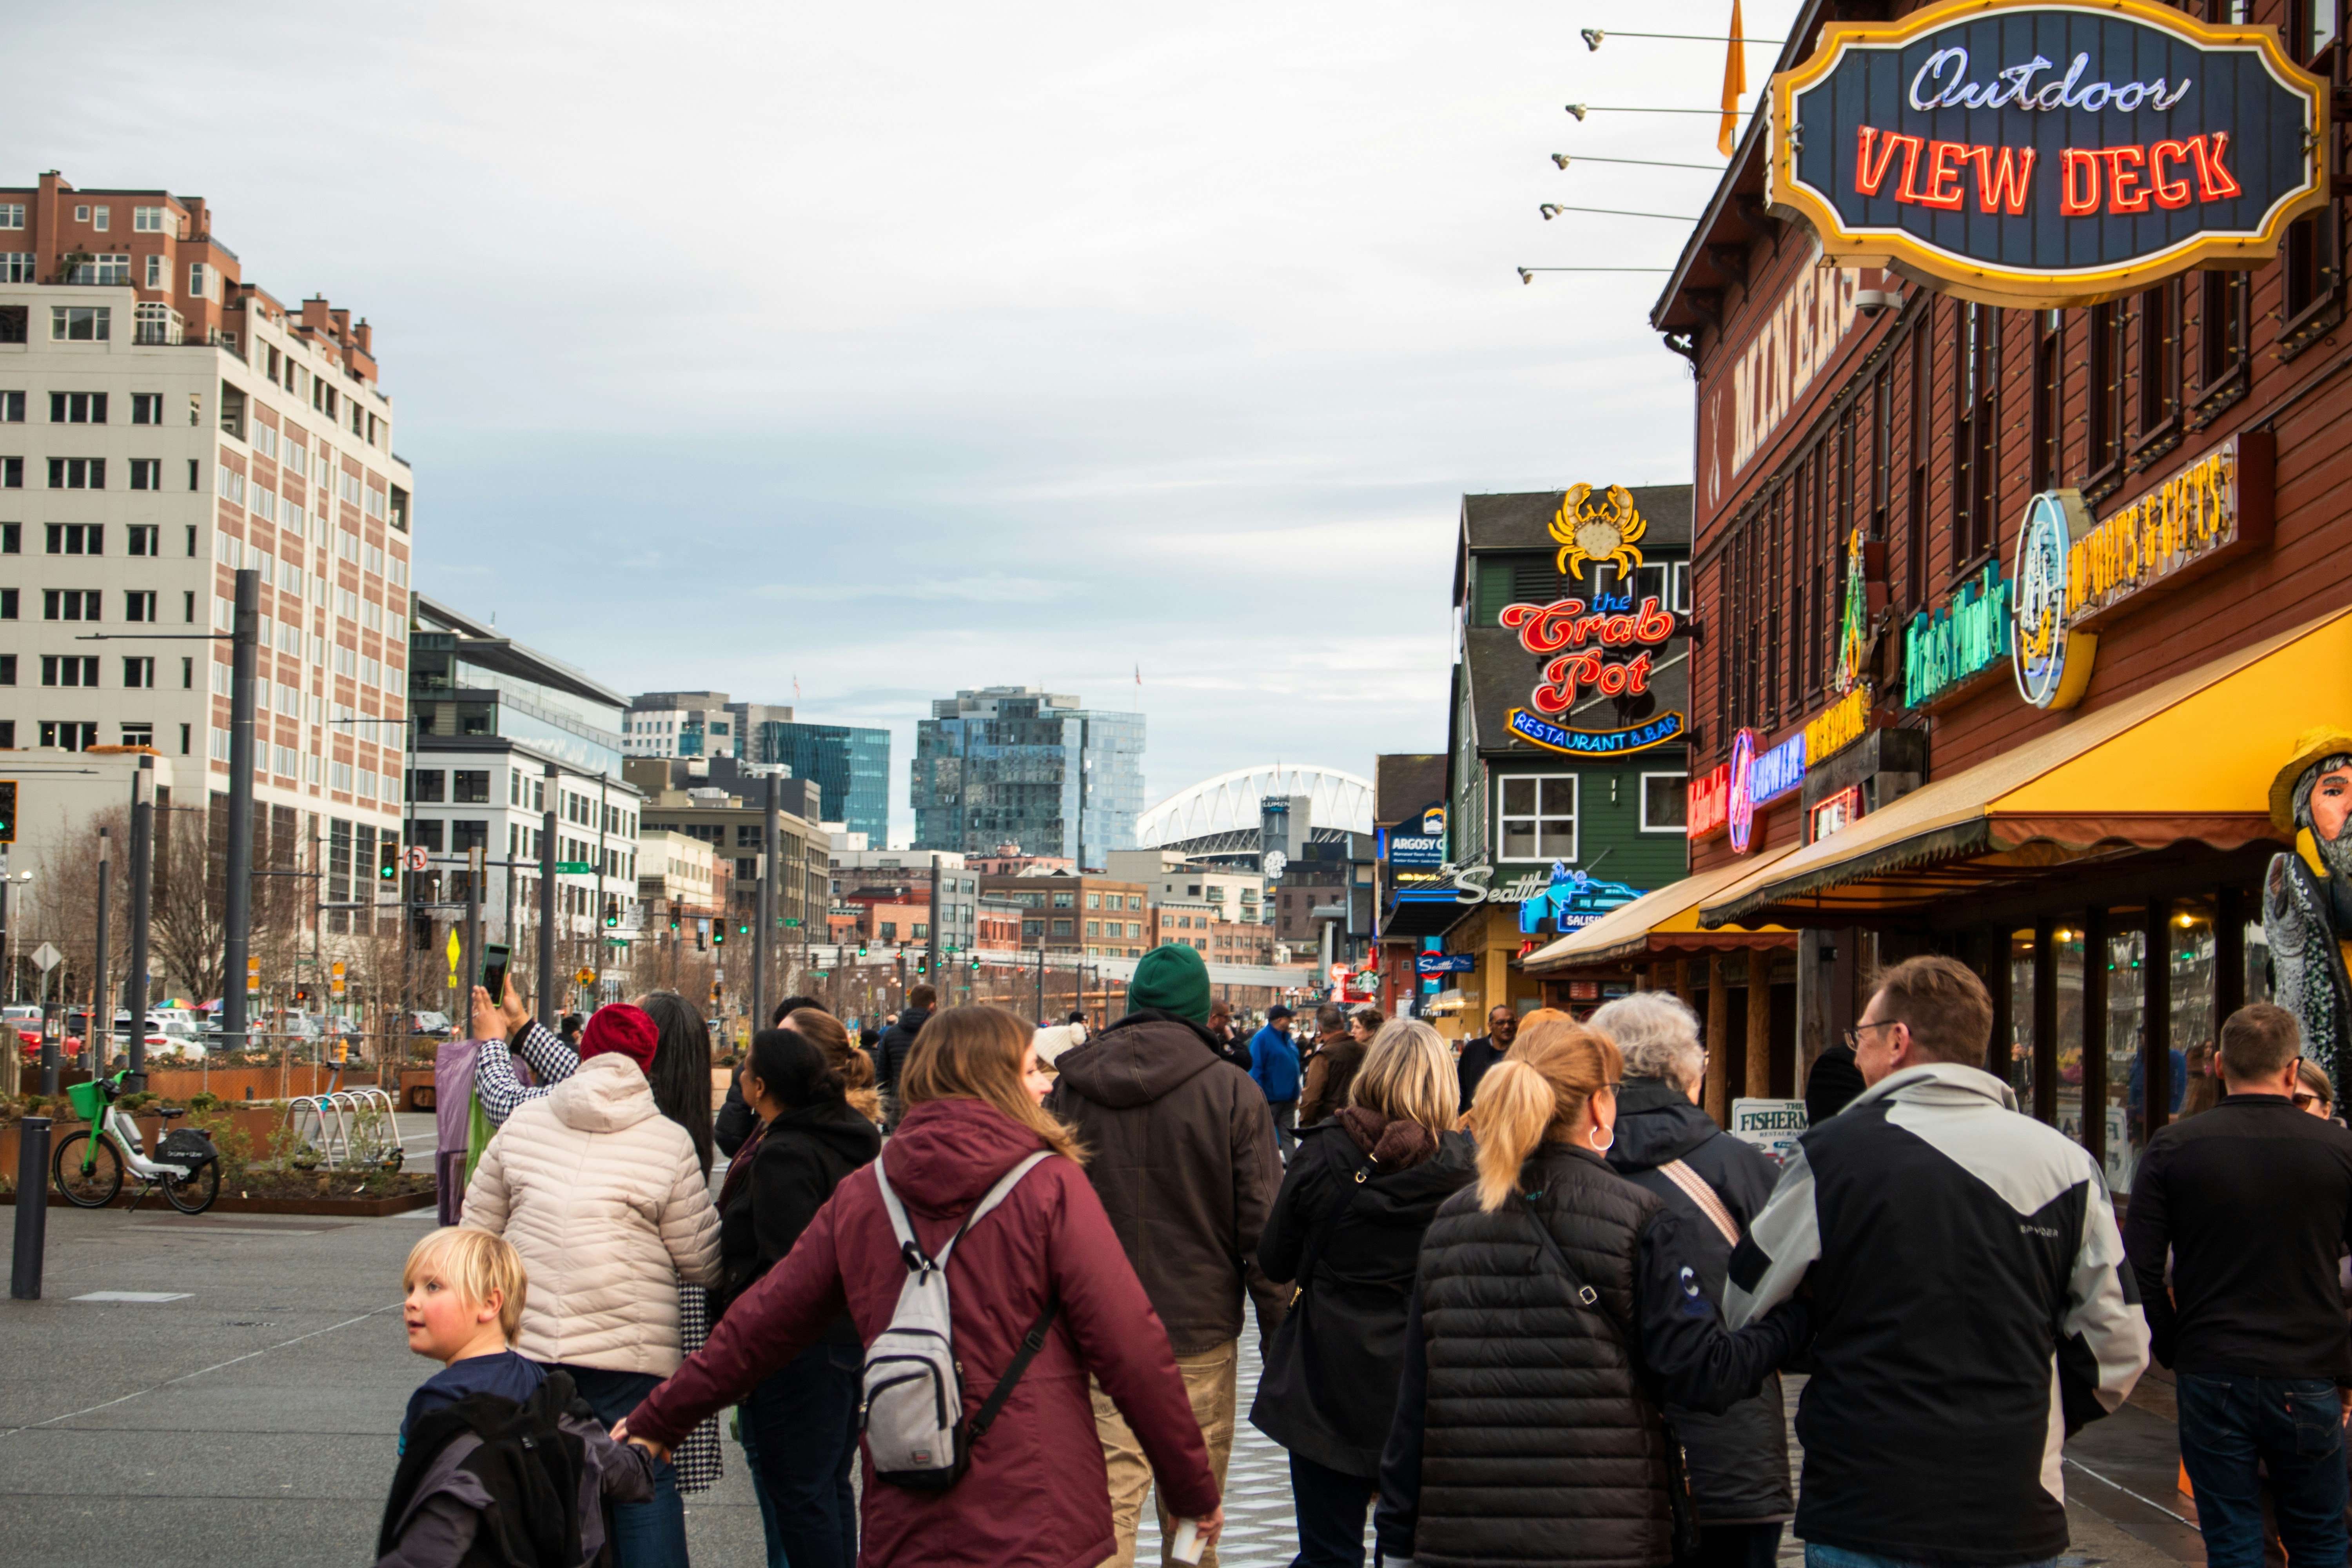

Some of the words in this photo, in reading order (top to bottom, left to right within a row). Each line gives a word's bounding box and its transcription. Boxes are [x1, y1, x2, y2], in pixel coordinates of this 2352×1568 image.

[1909, 46, 2192, 113] Outdoor
[1855, 125, 2036, 216] VIEW
[2059, 130, 2243, 216] DECK
[1592, 592, 1632, 613] the
[1499, 595, 1675, 654] Crab
[1532, 647, 1653, 714] Pot
[1514, 713, 1626, 751] RESTAURANT
[1631, 733, 1642, 745] &
[1646, 717, 1680, 741] BAR
[1392, 838, 1435, 850] ARGOSY
[1454, 866, 1551, 904] Seattle
[1419, 958, 1452, 971] Seattle
[2020, 1225, 2058, 1238] SPYDER
